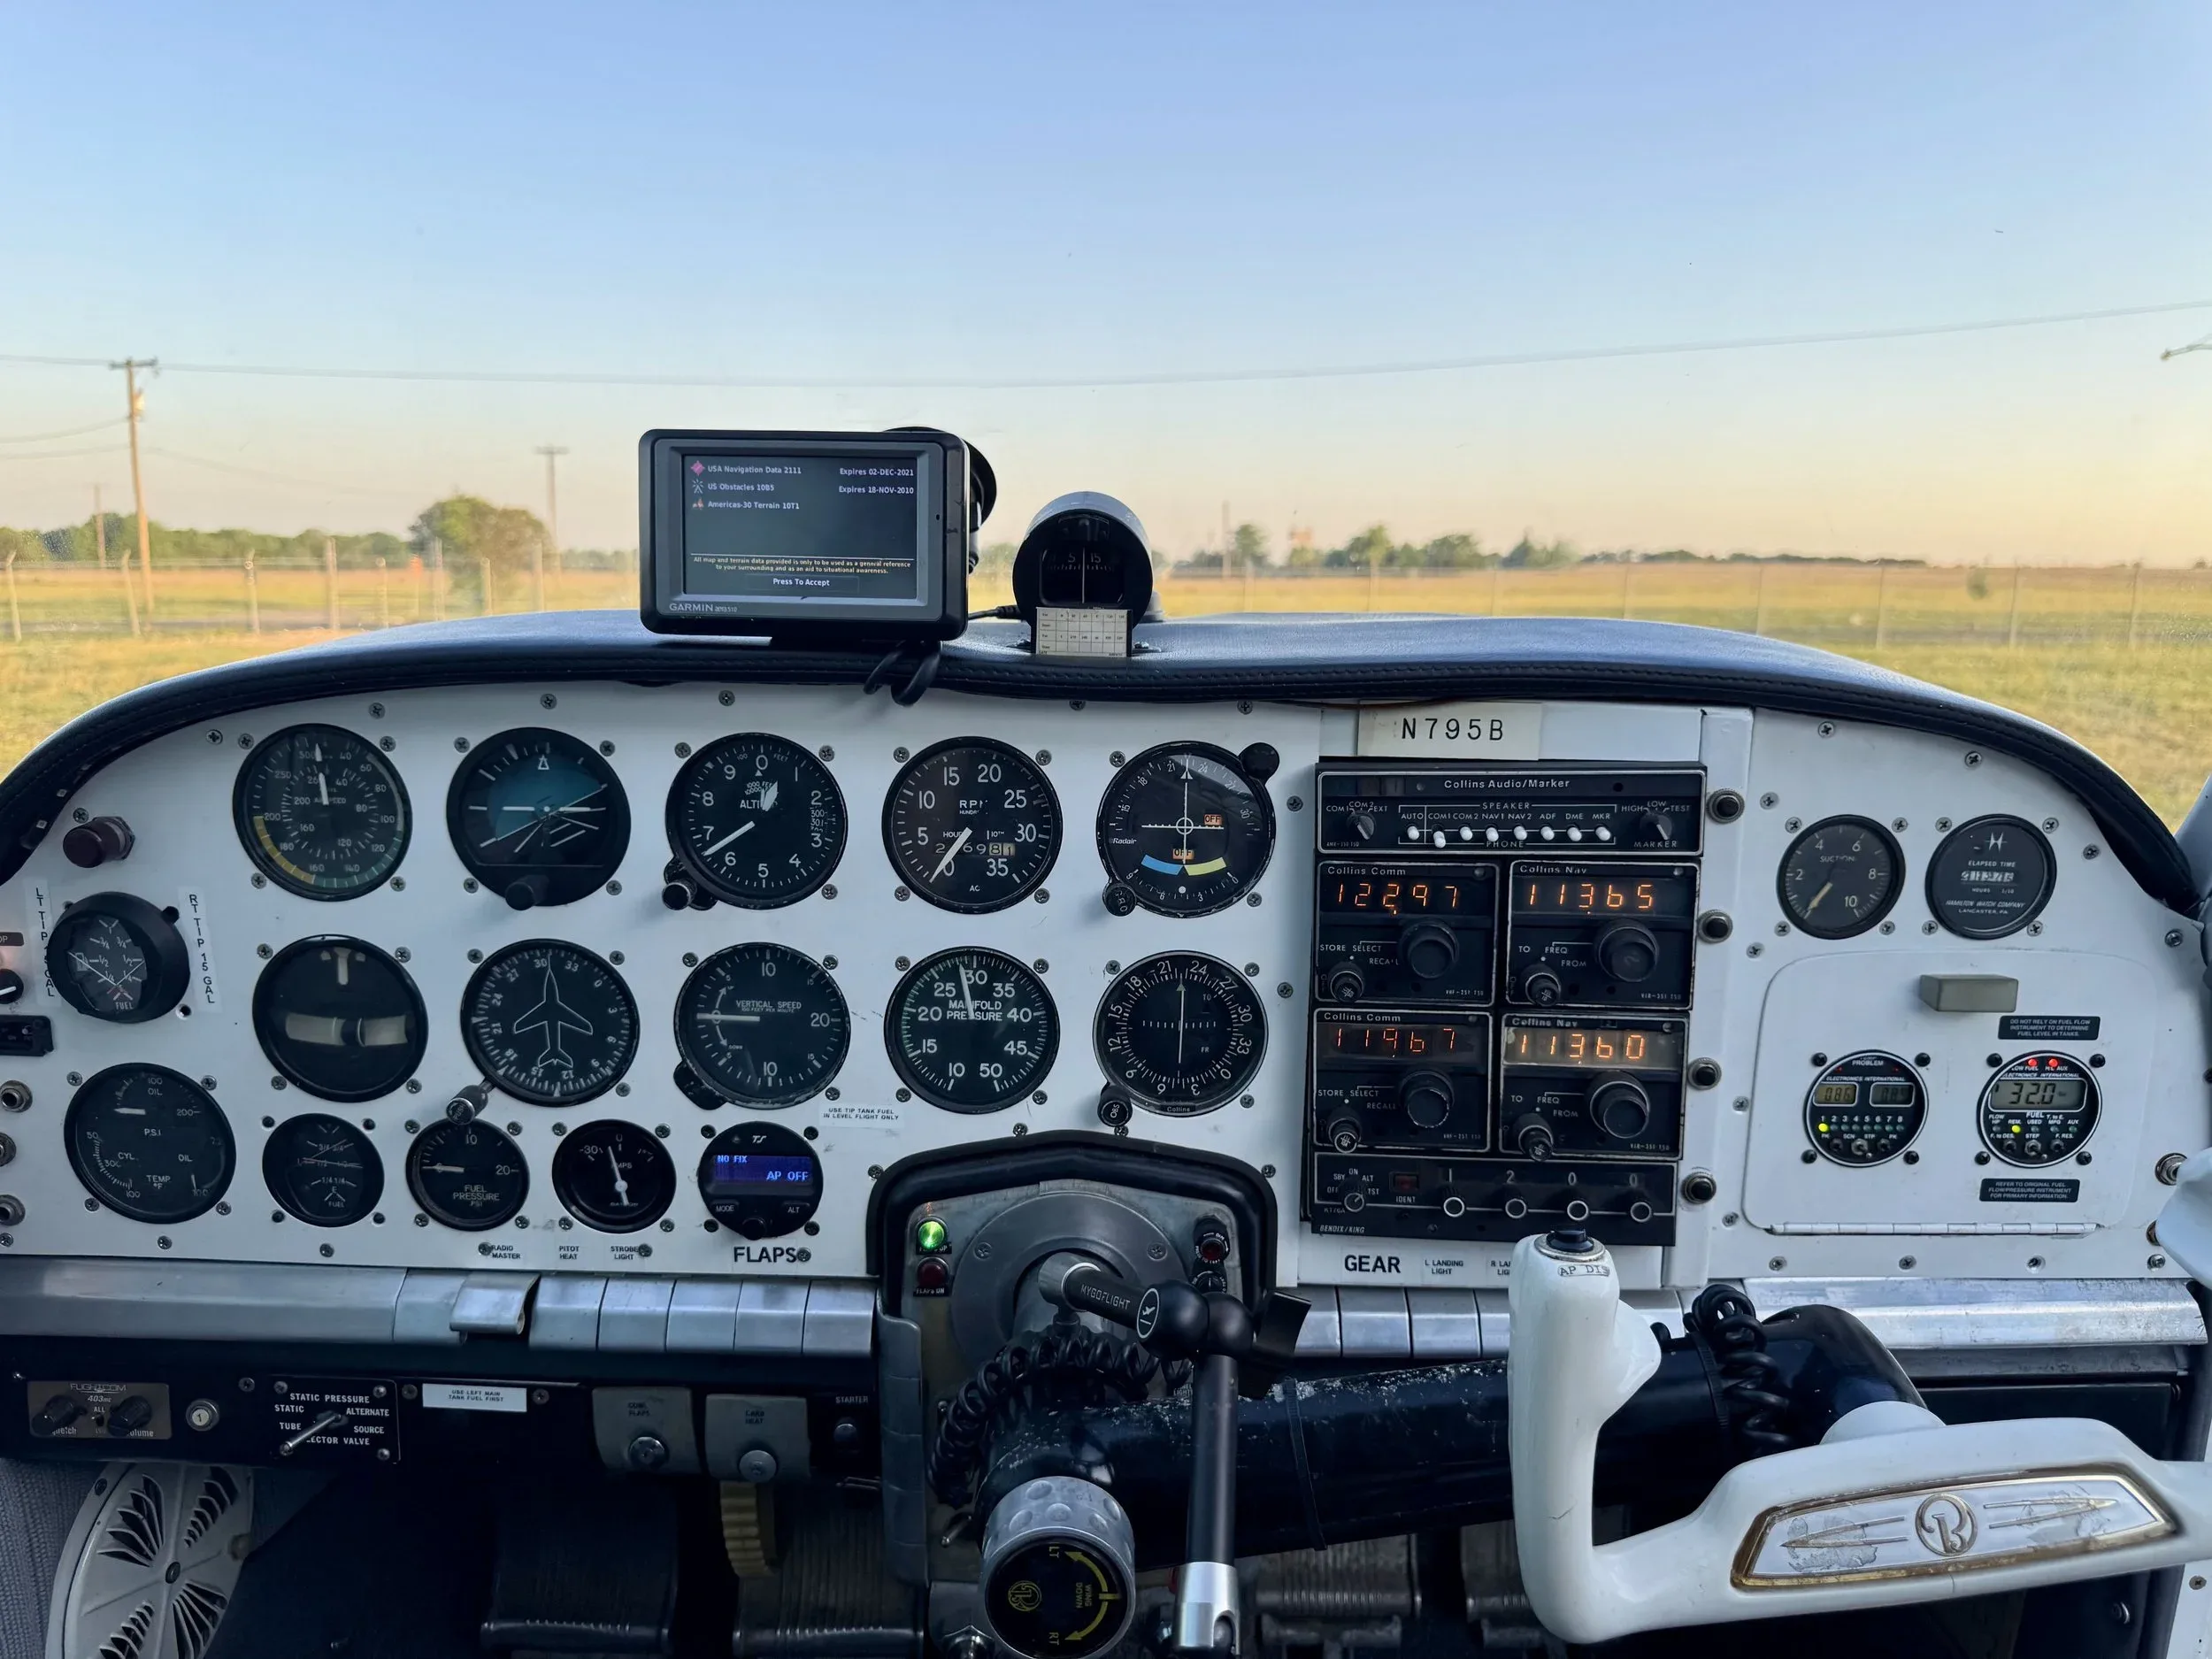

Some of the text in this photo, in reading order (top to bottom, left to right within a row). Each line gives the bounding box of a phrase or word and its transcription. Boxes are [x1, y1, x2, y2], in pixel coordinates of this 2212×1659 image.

[1090, 553, 1101, 563] 15
[670, 603, 713, 612] GARMIN
[1402, 718, 1504, 741] N795B
[724, 764, 736, 780] 9
[944, 764, 1002, 786] 15 20
[919, 790, 1026, 810] 10 25
[757, 864, 769, 878] 5
[1844, 895, 1857, 908] 10
[1190, 960, 1208, 974] 24
[934, 983, 1015, 997] 25 35
[810, 1013, 830, 1027] 20
[918, 1007, 941, 1021] 20
[1007, 1008, 1032, 1023] 40
[2009, 1083, 2055, 1104] 32.0
[766, 1171, 808, 1180] AP OFF
[453, 1193, 499, 1202] PRESSURE
[733, 1247, 795, 1263] FLAPS
[1344, 1255, 1401, 1272] GEAR
[1560, 1265, 1576, 1276] AP
[1080, 1283, 1130, 1310] MYGOFLIGHT
[290, 1394, 370, 1403] STATIC PRESSURE
[275, 1404, 304, 1413] STATIC
[346, 1408, 389, 1417] ALTERNATE
[354, 1425, 384, 1434] SOURCE
[343, 1436, 370, 1446] VALVE
